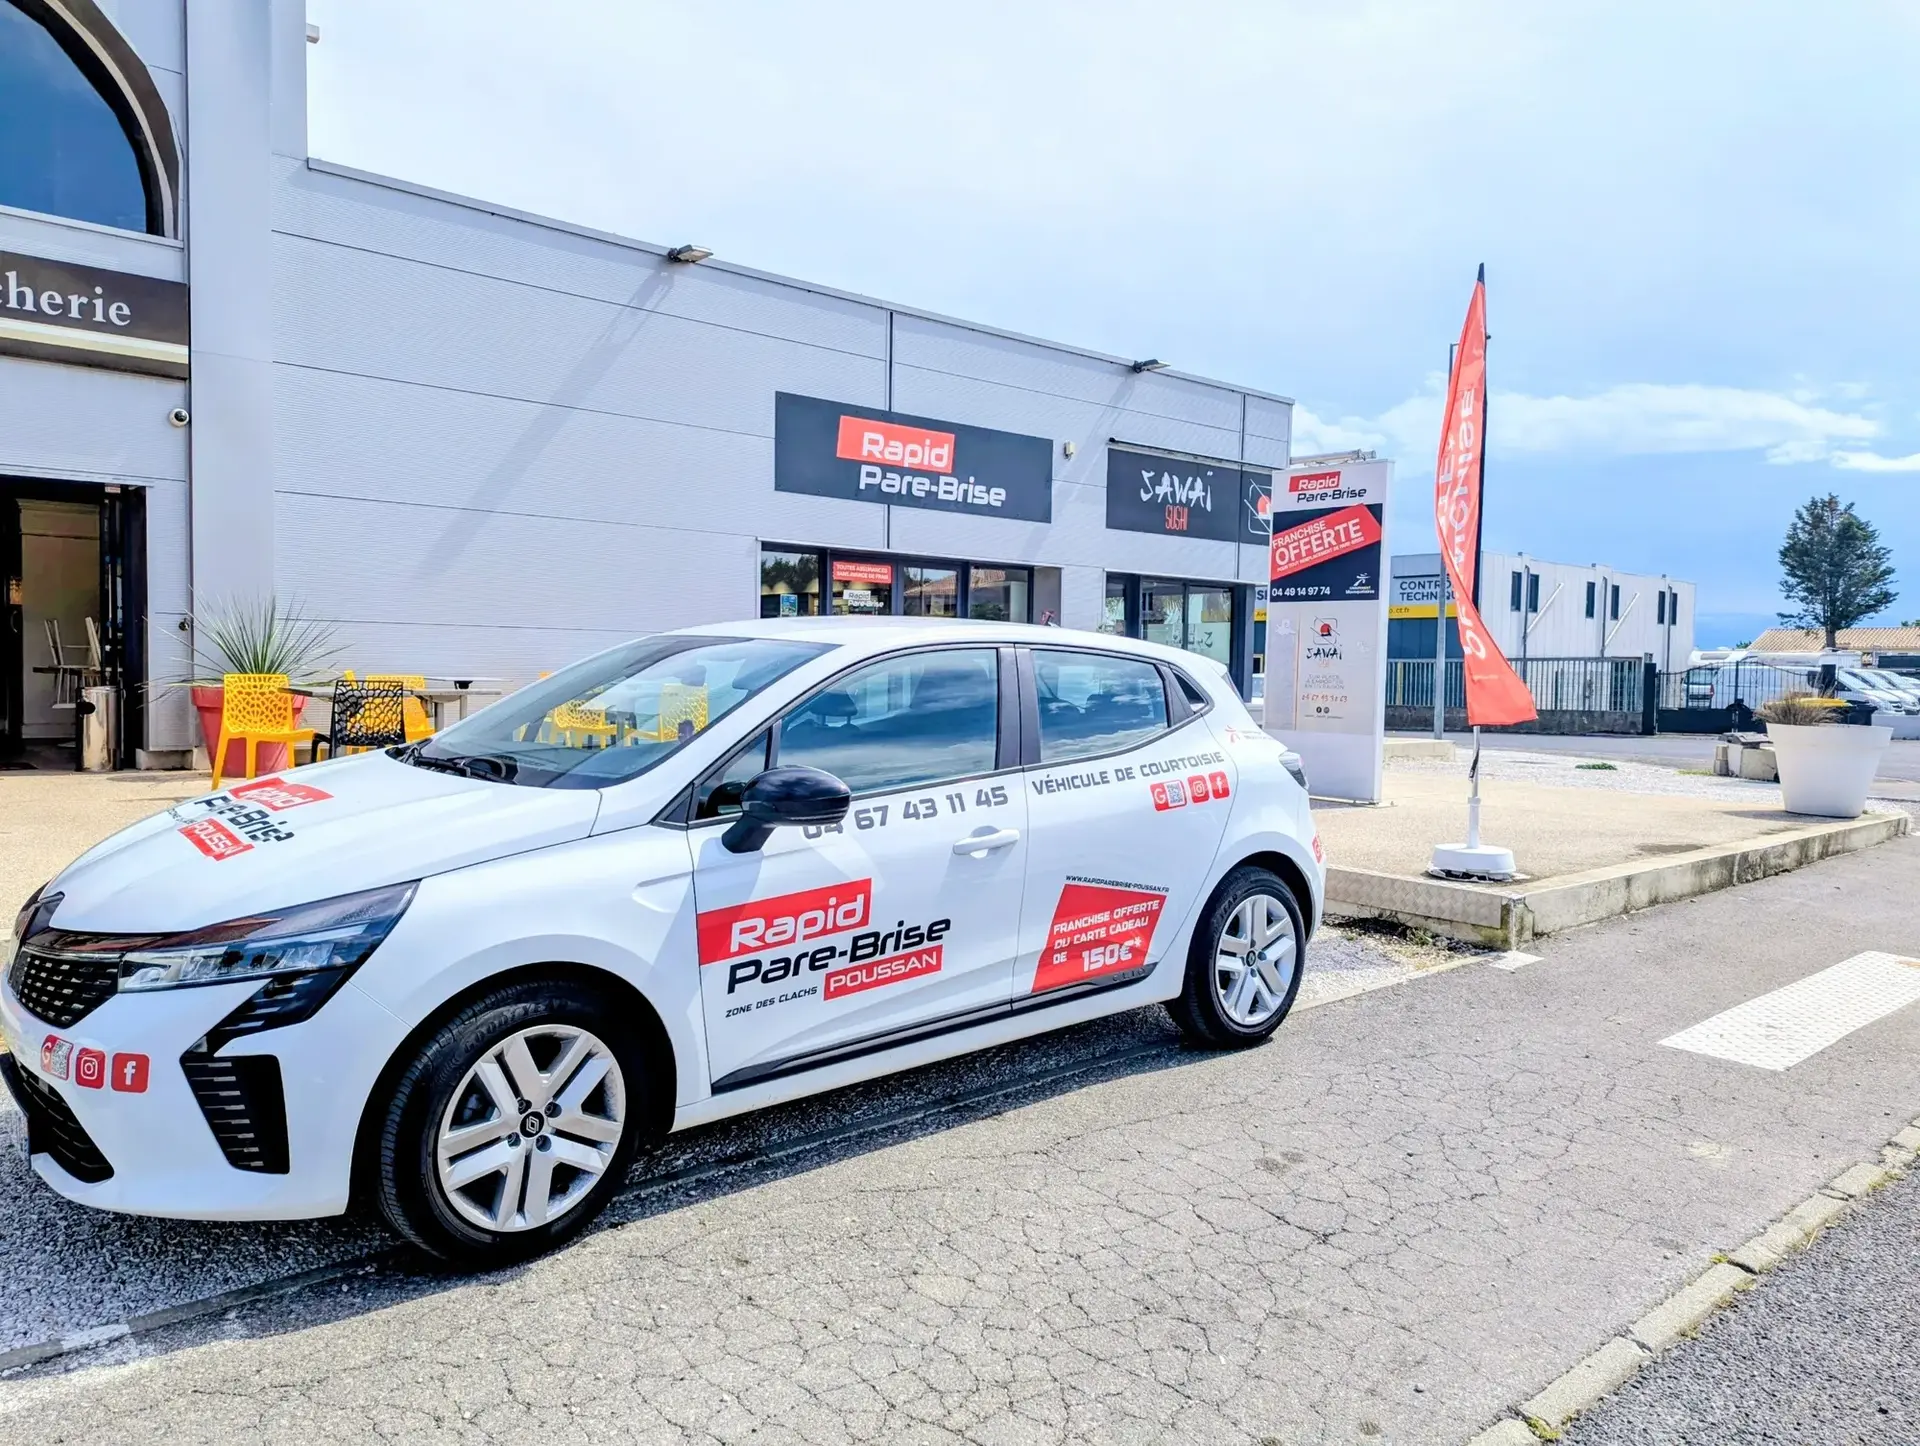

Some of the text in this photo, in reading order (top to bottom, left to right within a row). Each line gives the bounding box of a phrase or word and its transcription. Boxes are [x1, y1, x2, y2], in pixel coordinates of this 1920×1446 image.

[0, 270, 131, 326] herie
[862, 431, 950, 468] Rapid
[859, 464, 1007, 507] Pare-Brise
[1297, 487, 1367, 503] Pare-Brise
[1298, 475, 1338, 490] Rapid
[1165, 504, 1189, 531] SUSHI
[1272, 520, 1326, 549] FRANCHISE
[1275, 518, 1362, 565] OFFERTE
[849, 591, 870, 600] Rapid
[1272, 586, 1330, 596] 04 49 14 97 74
[1032, 752, 1224, 795] VÉHICULE DE COURTOISIE
[854, 805, 889, 830] 67
[903, 797, 938, 820] 43
[945, 793, 966, 814] 11
[976, 785, 1009, 808] 45
[730, 893, 864, 953] Rapid
[1054, 900, 1160, 935] FRANCHISE OFFERTE
[1073, 927, 1107, 945] CARTE
[1109, 916, 1149, 935] CADEAU
[727, 918, 951, 995] Pare-Brise
[829, 951, 937, 992] POUSSAN
[1053, 952, 1067, 965] DE
[725, 986, 818, 1018] ZONE DES CLACHS
